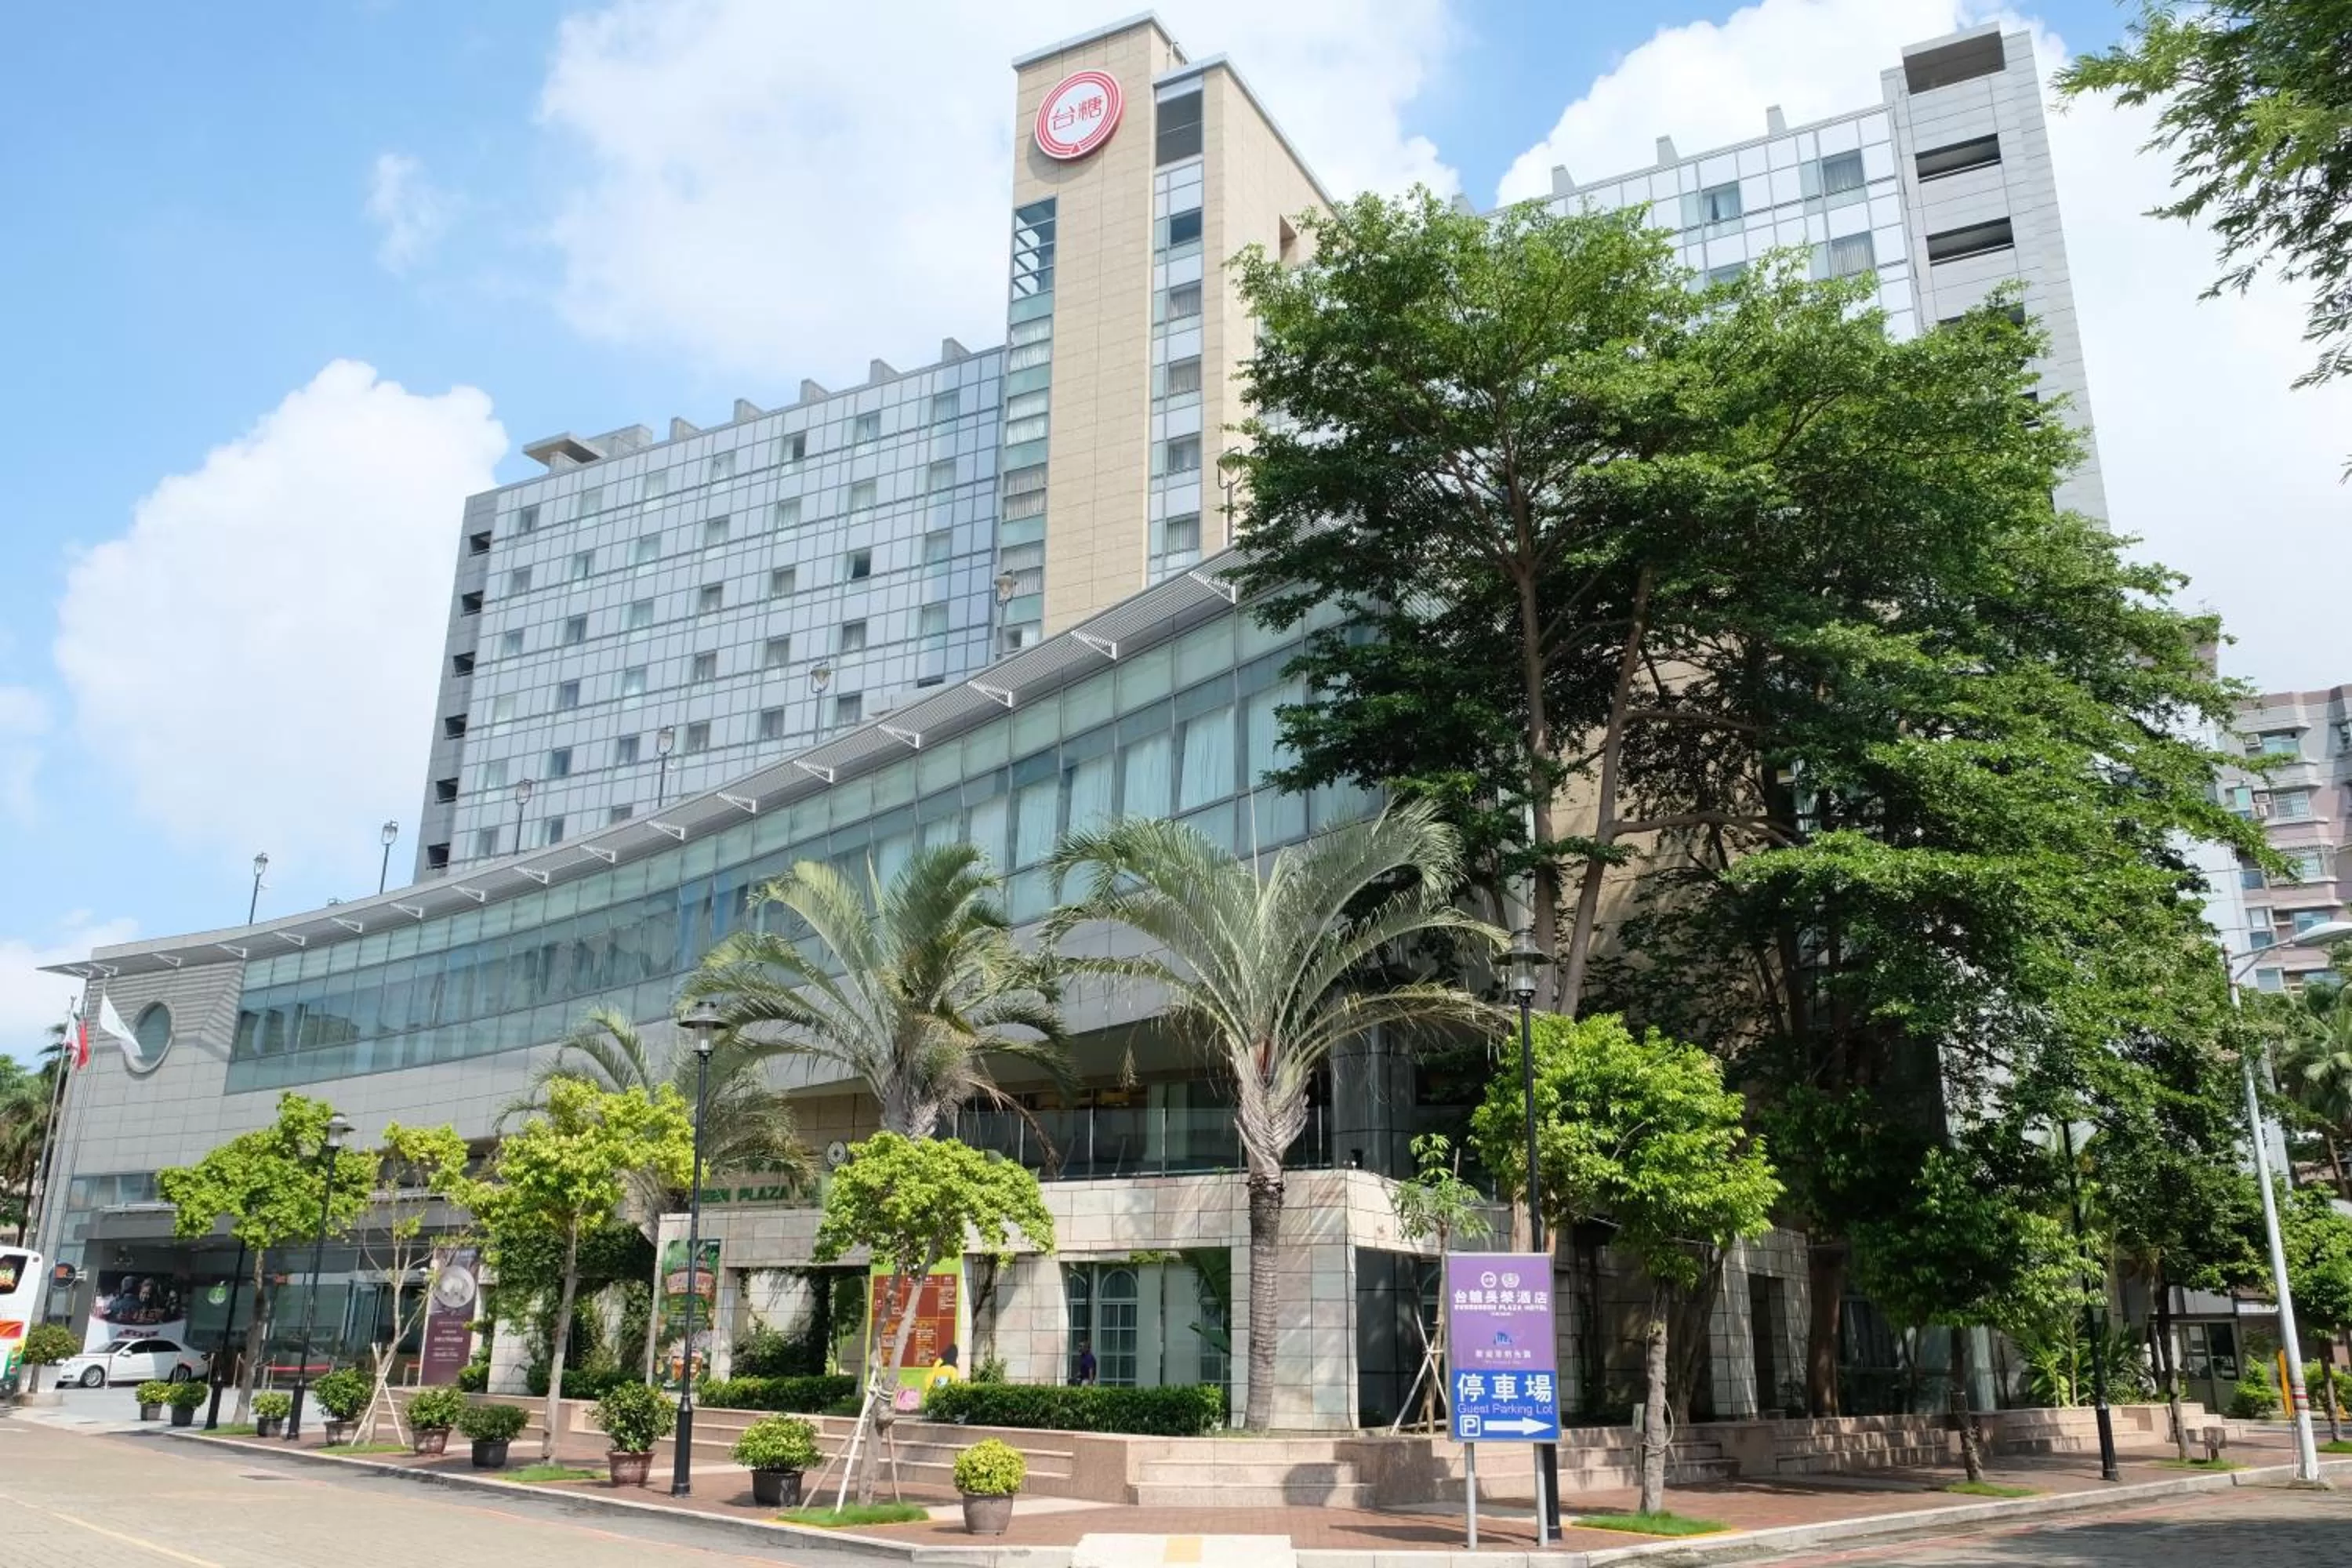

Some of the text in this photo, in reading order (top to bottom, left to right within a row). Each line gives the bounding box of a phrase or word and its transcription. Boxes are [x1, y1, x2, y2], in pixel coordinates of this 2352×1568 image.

[1051, 96, 1102, 130] 台糖
[737, 1185, 789, 1201] PLAZA
[1457, 1373, 1553, 1403] 停車場
[1457, 1403, 1553, 1416] Guest Parking Lot
